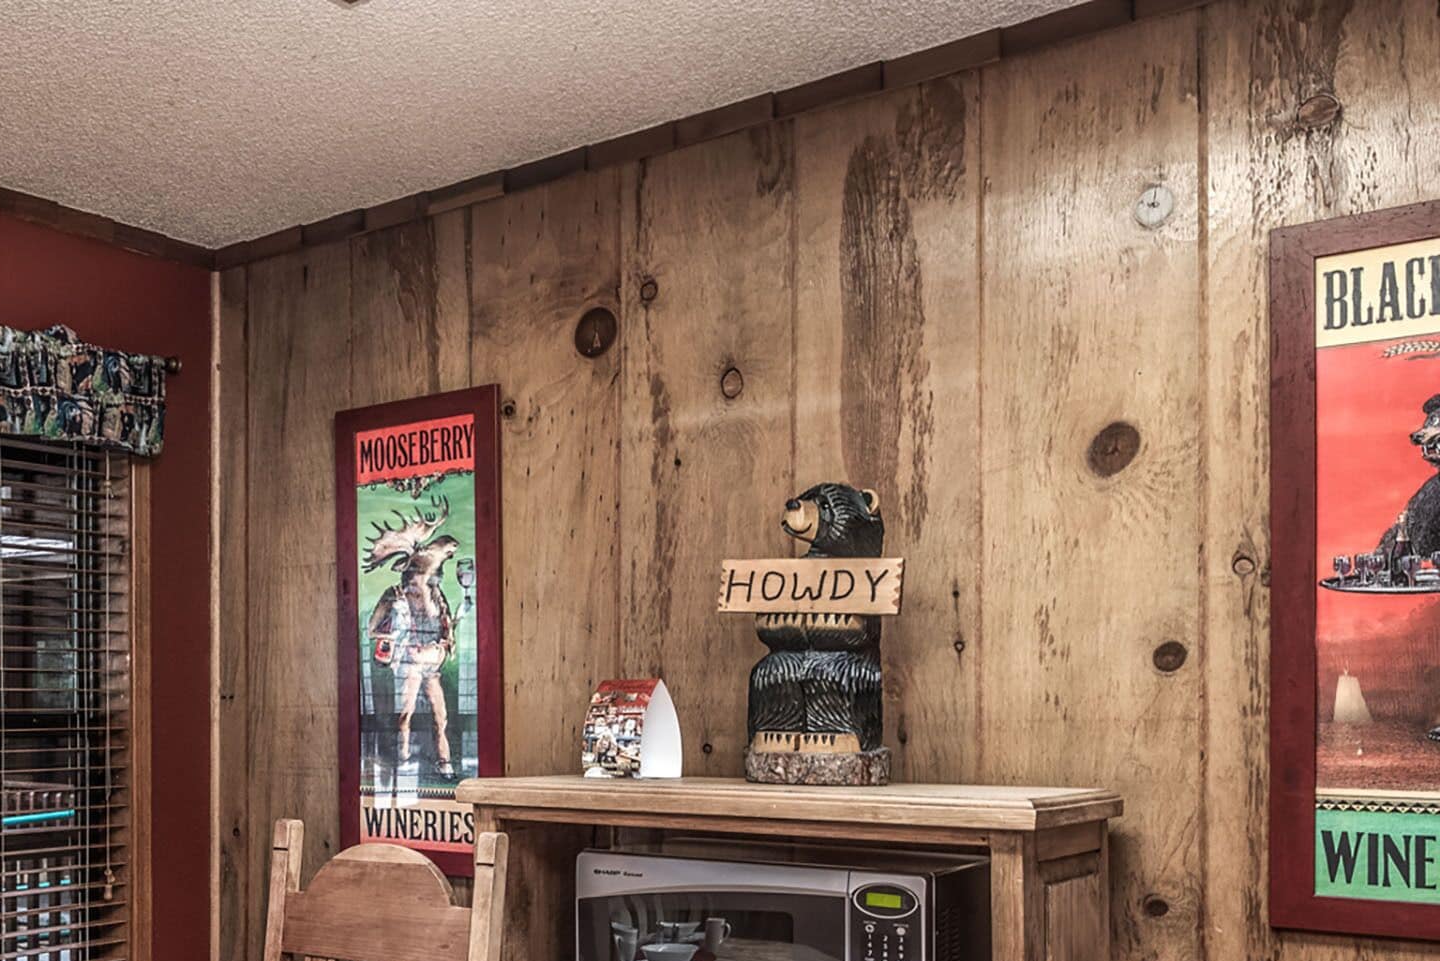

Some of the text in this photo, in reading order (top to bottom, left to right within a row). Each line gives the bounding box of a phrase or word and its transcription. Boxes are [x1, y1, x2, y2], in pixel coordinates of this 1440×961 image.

[360, 423, 474, 474] MOOSEBERRY
[725, 569, 889, 602] HOWDY
[363, 807, 475, 845] WINERIES
[1321, 830, 1437, 890] WINE
